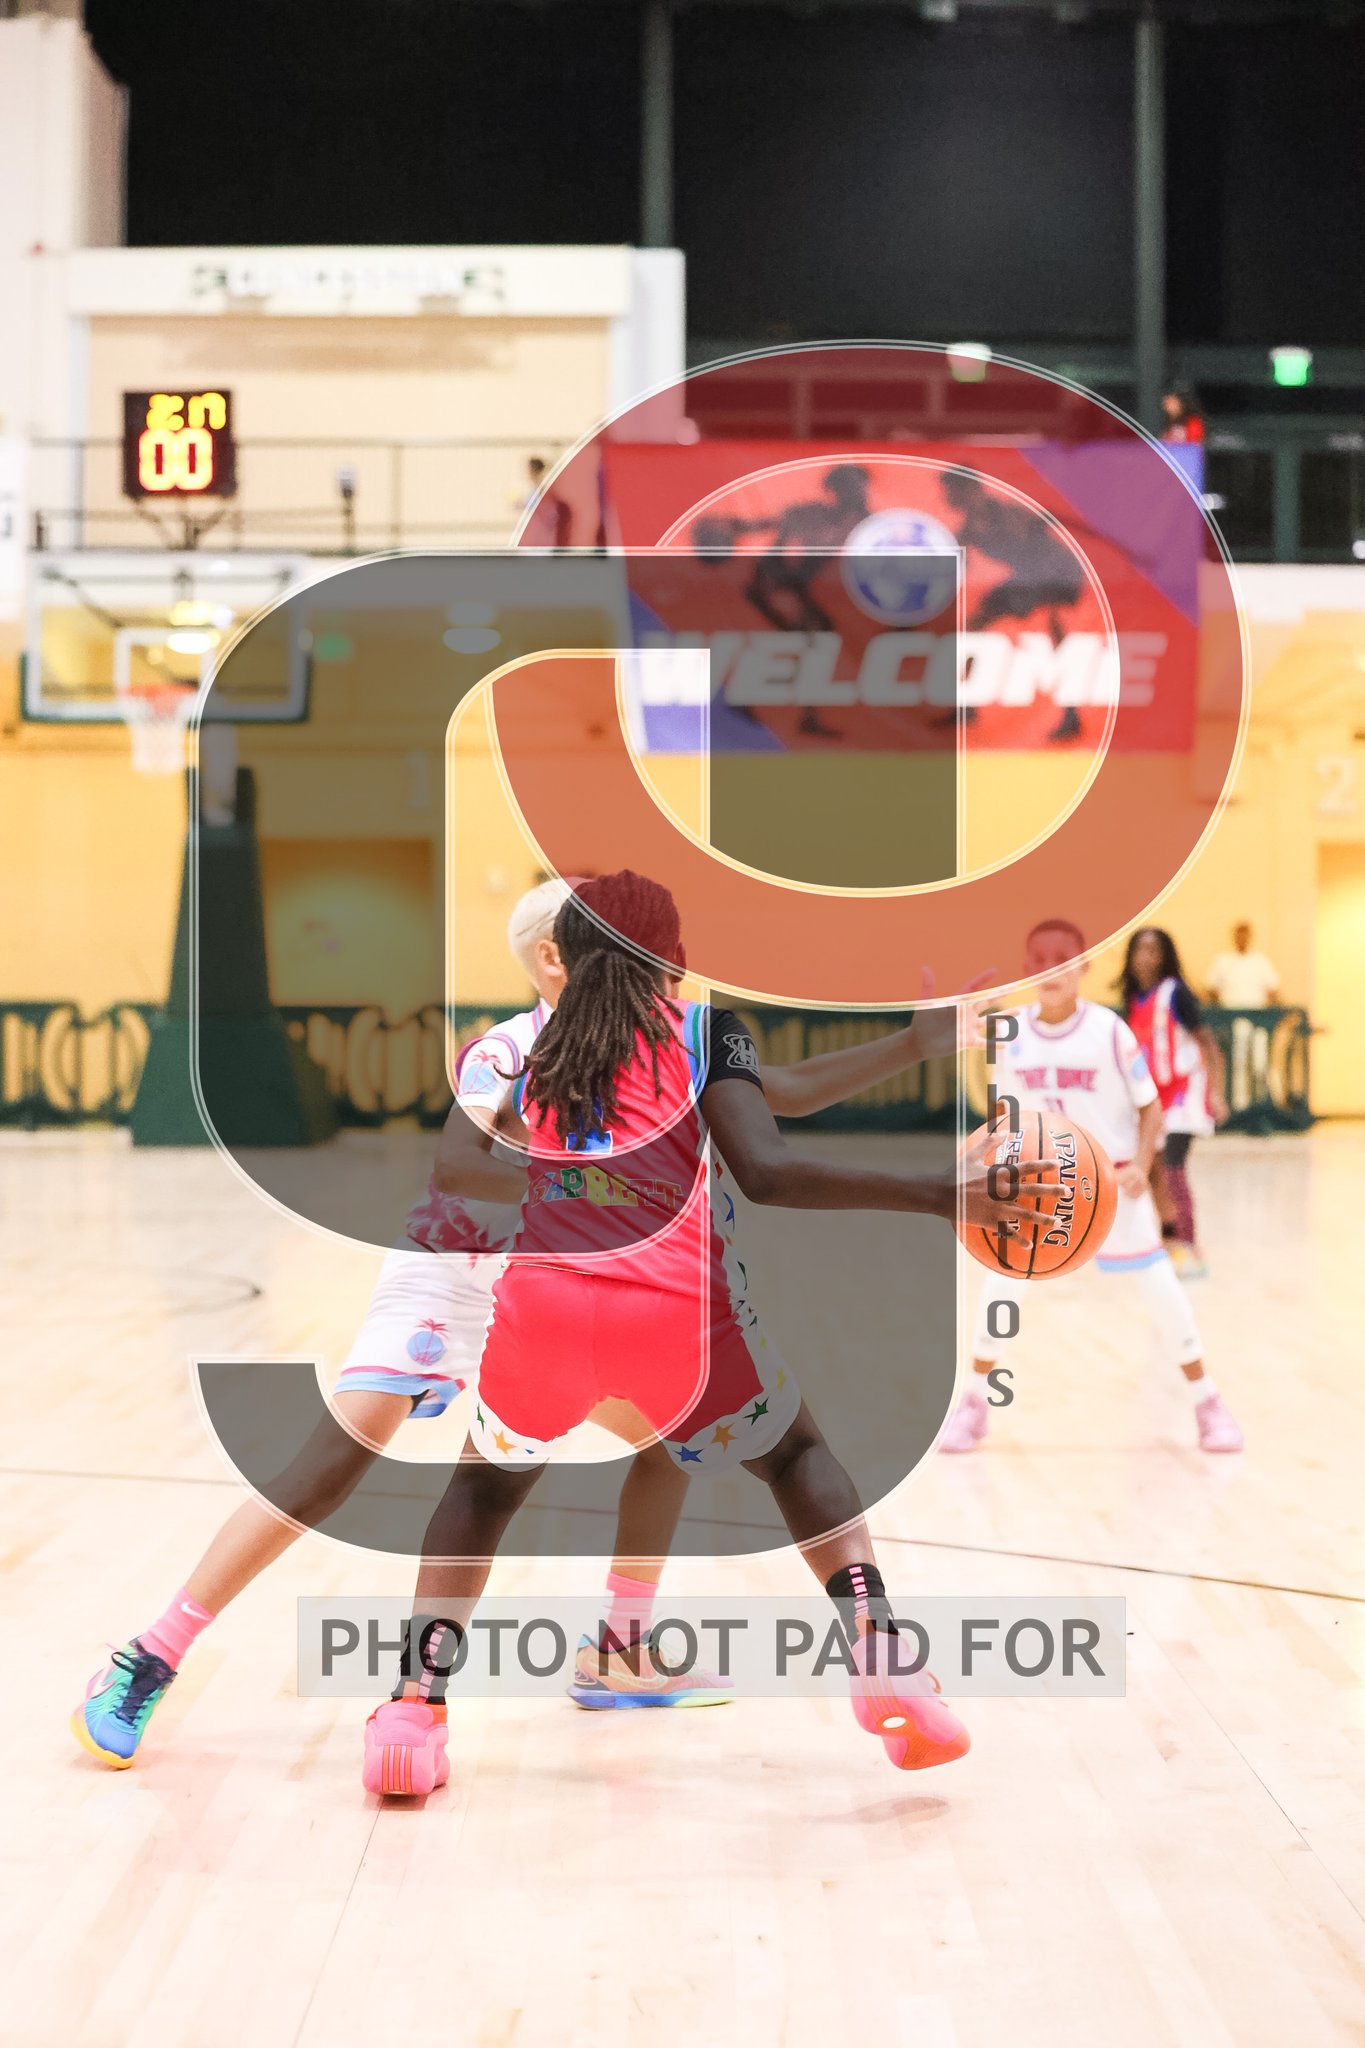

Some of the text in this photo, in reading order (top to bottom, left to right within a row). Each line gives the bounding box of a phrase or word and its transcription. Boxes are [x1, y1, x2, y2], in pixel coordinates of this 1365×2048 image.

[138, 427, 213, 491] 00
[641, 630, 1167, 706] WELCOME
[1042, 1129, 1077, 1247] SPALDING
